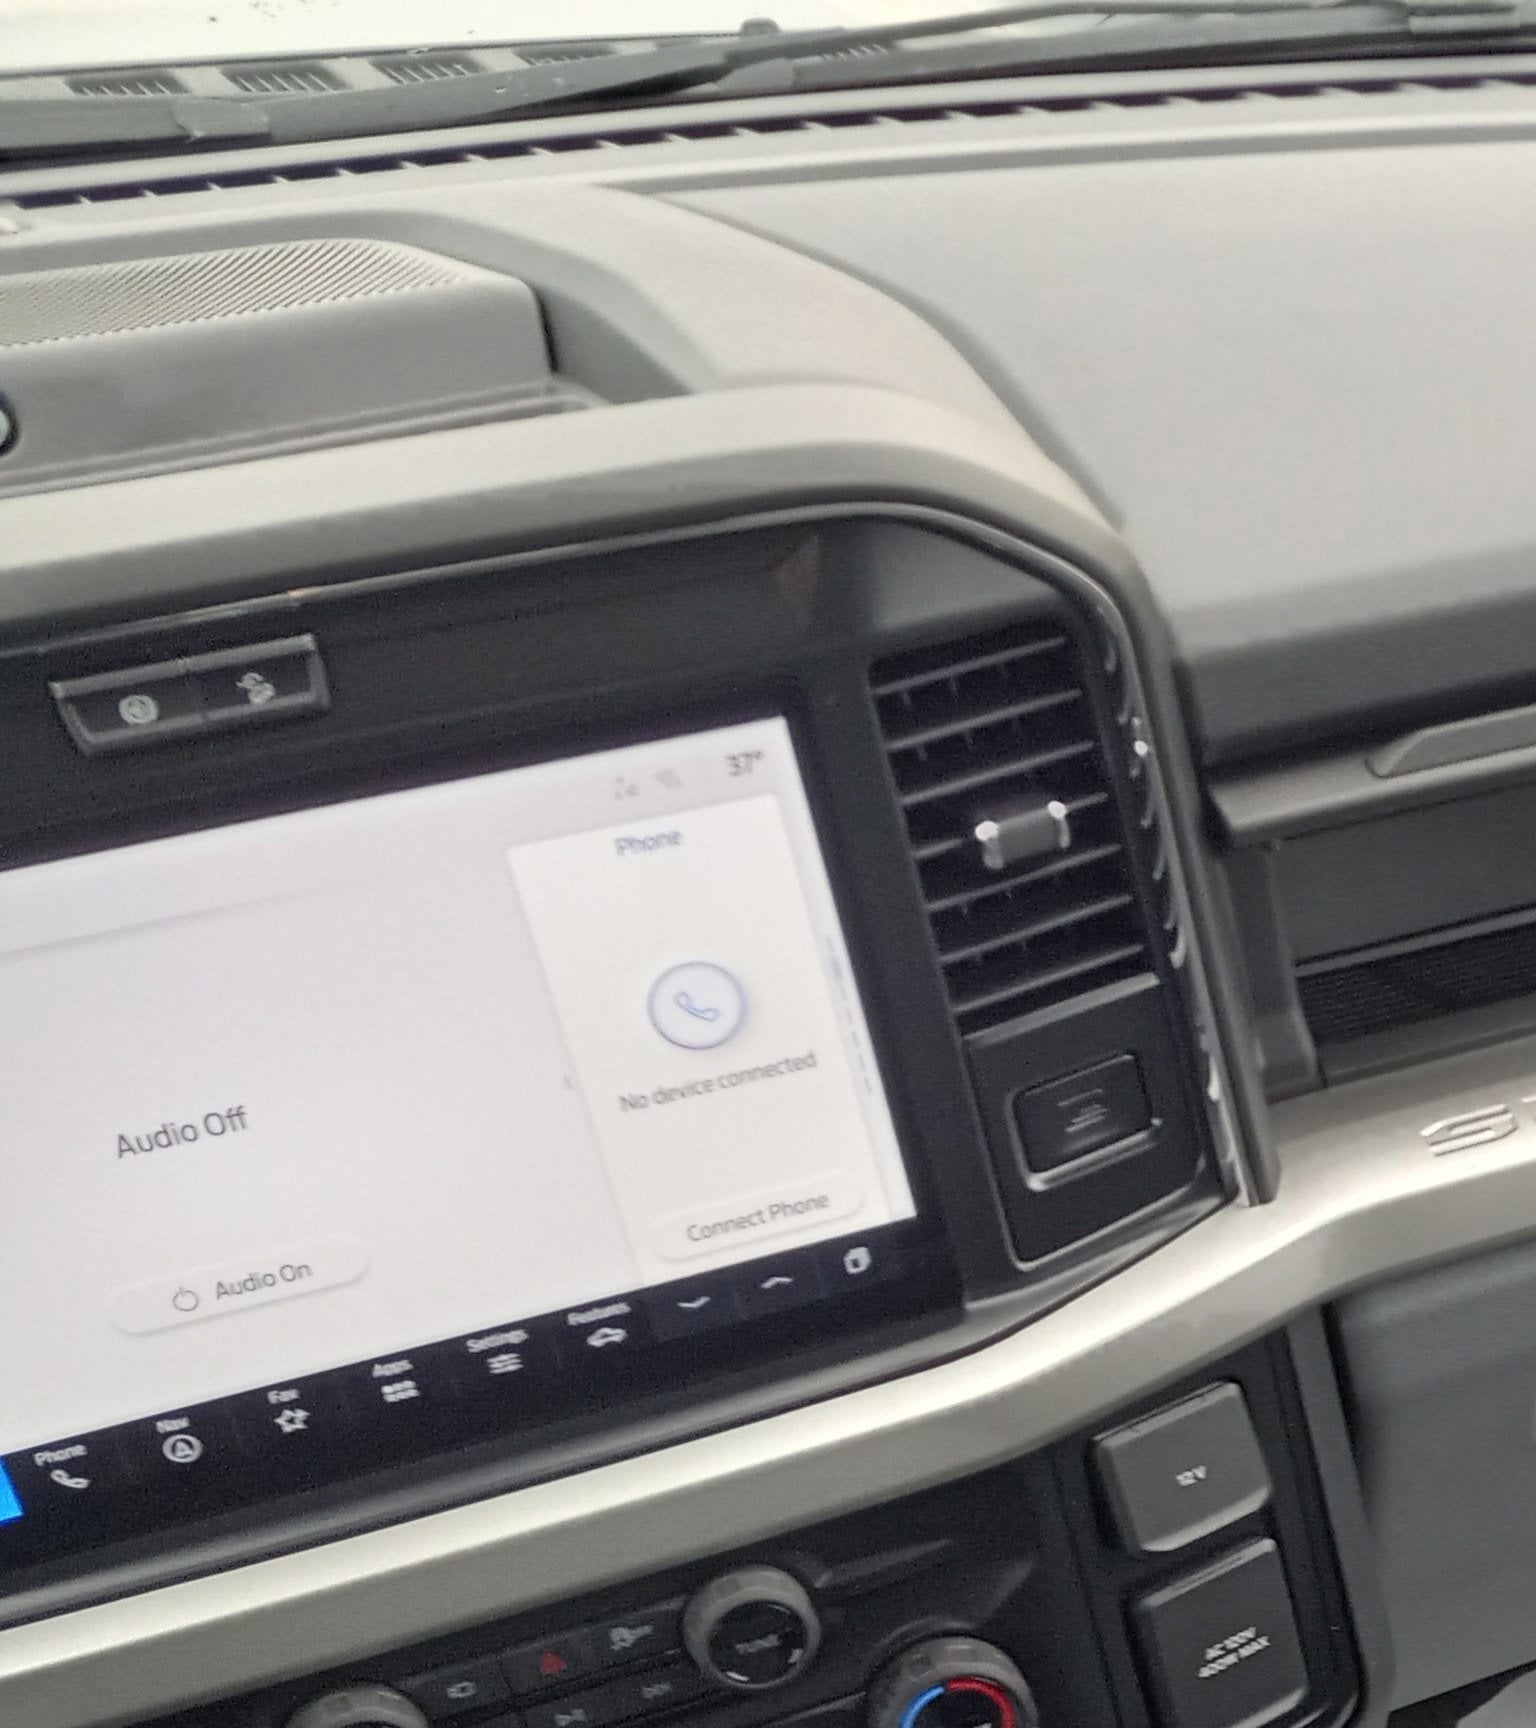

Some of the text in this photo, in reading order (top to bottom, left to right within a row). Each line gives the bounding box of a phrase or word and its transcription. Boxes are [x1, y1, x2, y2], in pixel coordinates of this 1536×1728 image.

[614, 830, 683, 856] Phone
[618, 1050, 818, 1112] No device connected
[117, 1105, 248, 1159] Audio Off
[686, 1194, 830, 1242] Connect Phone
[216, 1264, 312, 1300] Audio On
[466, 1329, 529, 1353] Settings
[372, 1359, 413, 1377] Apps
[33, 1444, 88, 1466] Phone
[1175, 1465, 1207, 1487] 12V
[1238, 1635, 1271, 1659] MAX
